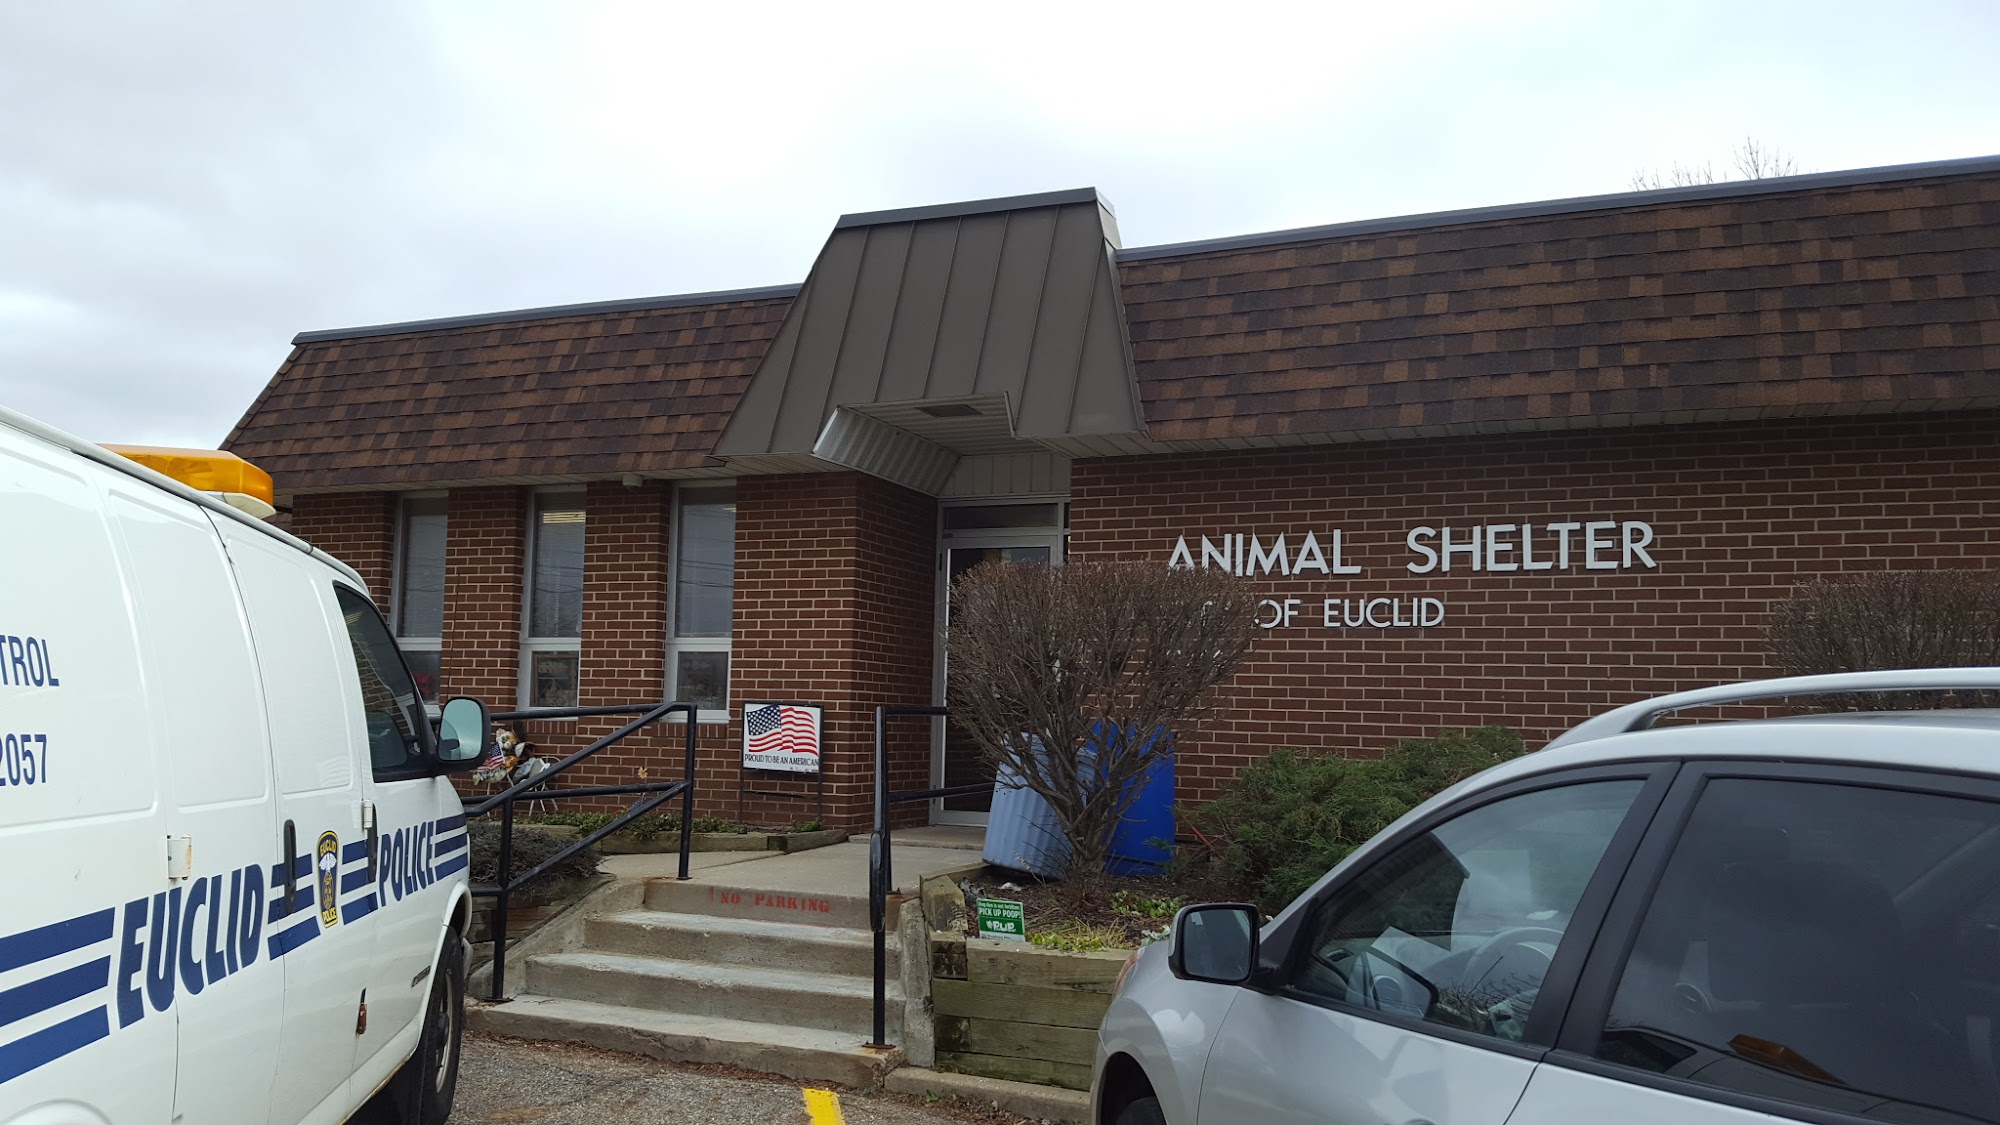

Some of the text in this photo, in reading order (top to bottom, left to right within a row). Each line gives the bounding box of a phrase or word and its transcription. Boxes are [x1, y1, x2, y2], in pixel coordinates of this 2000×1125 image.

[1167, 520, 1658, 577] ANIMAL SHELTER
[1253, 598, 1301, 629] OF
[1323, 597, 1445, 629] EUCLID
[744, 754, 820, 766] PROUD TO BE AN AMERICAN
[320, 839, 337, 856] EUCLID
[380, 821, 435, 907] POLICE
[720, 891, 831, 912] NO PARKING
[979, 907, 992, 916] PICK
[993, 909, 1001, 917] UP
[322, 907, 337, 922] POLICE
[116, 863, 265, 1029] EUCLID
